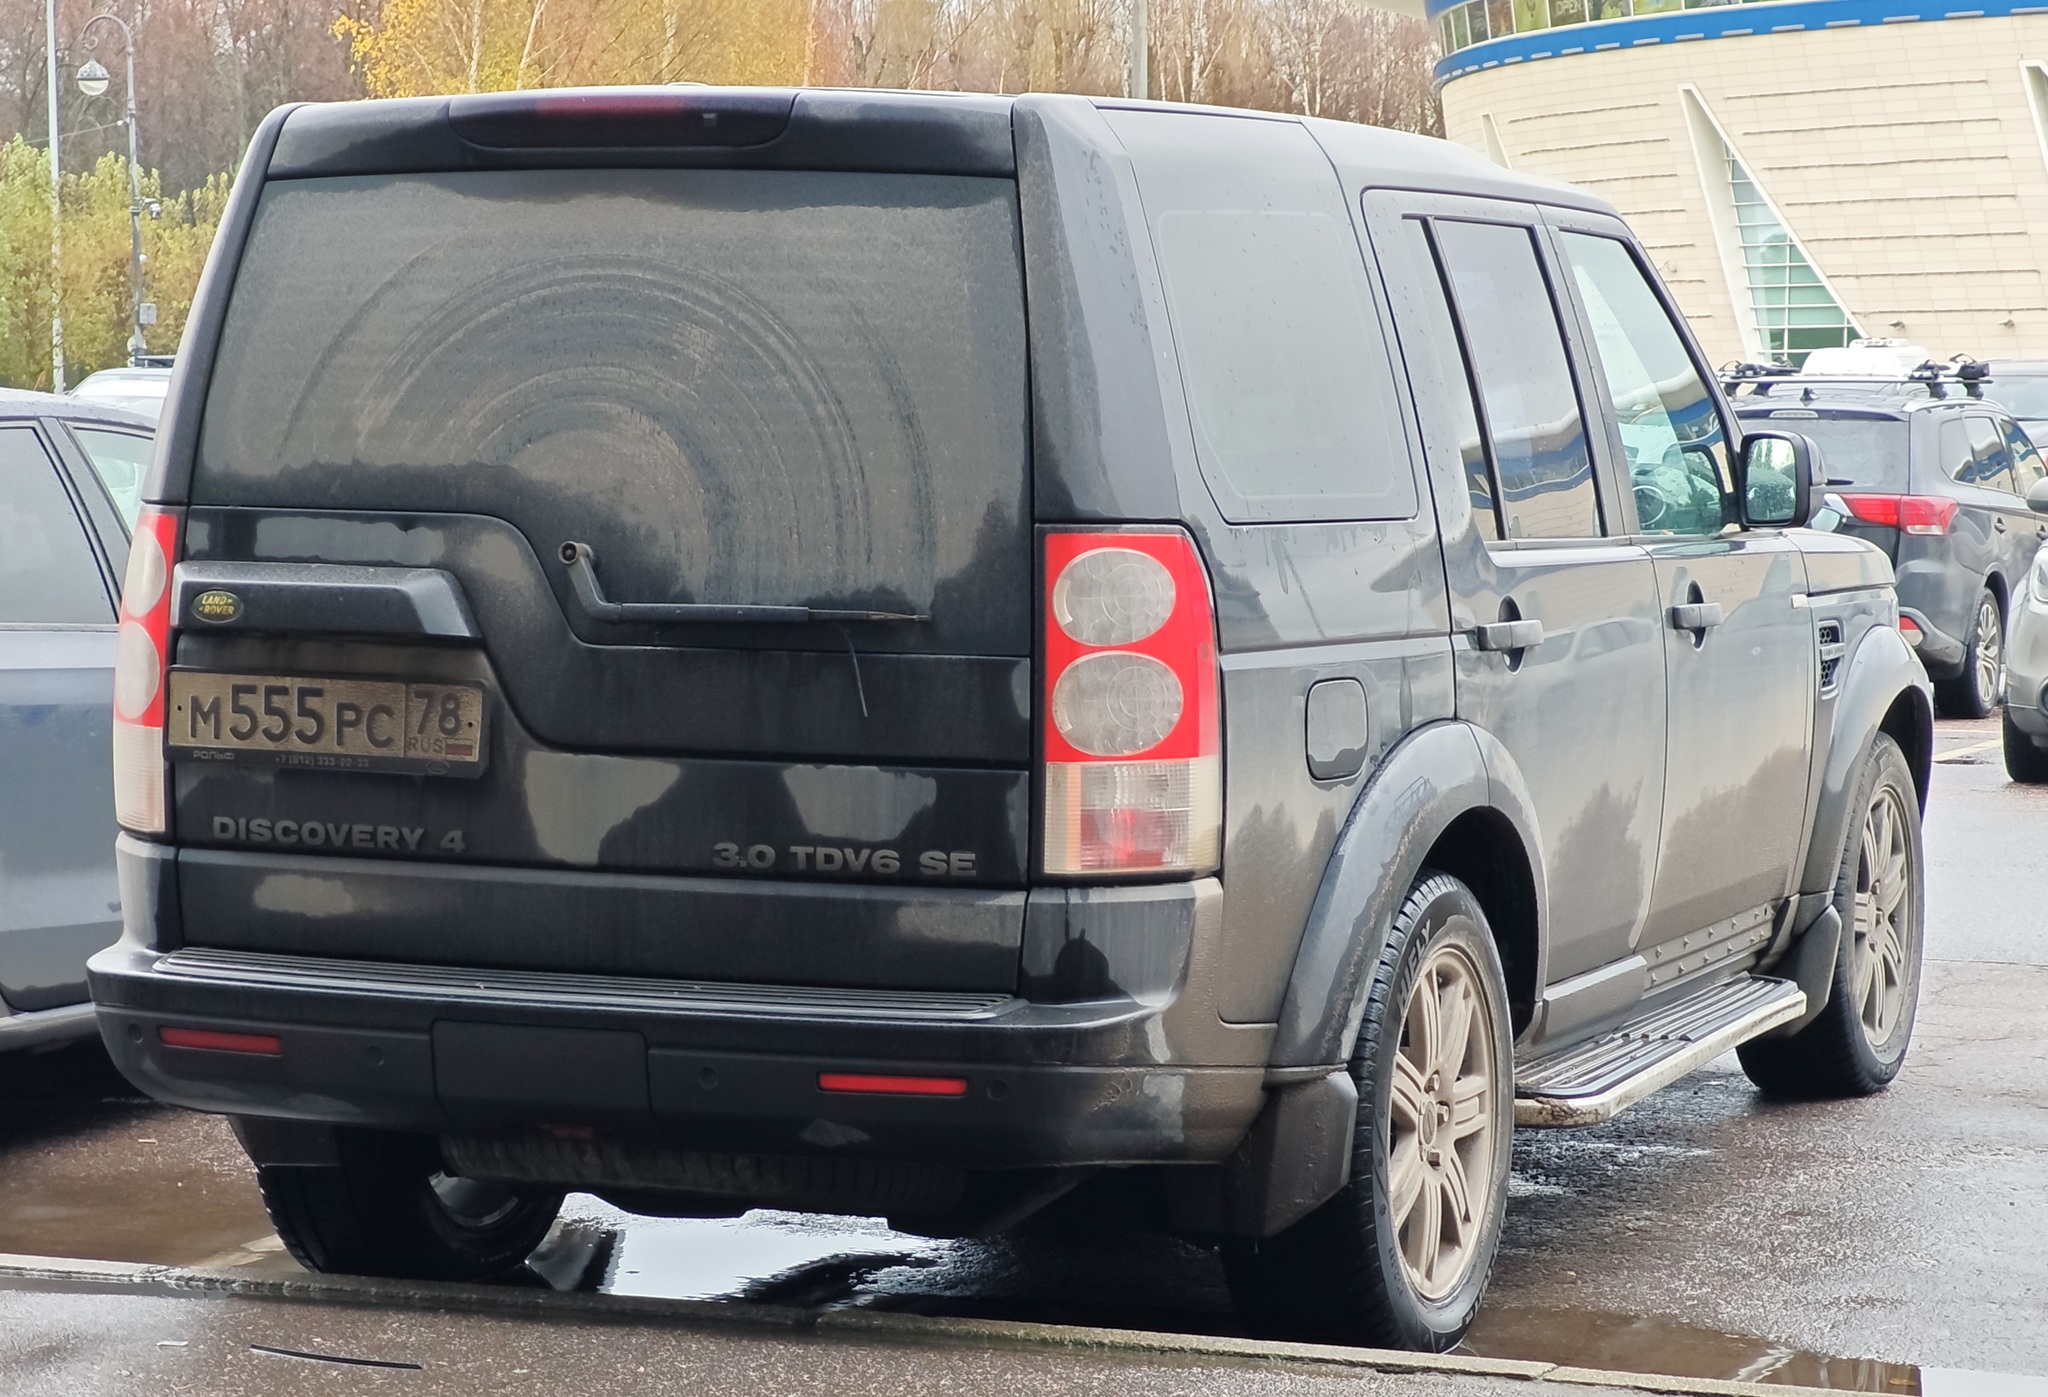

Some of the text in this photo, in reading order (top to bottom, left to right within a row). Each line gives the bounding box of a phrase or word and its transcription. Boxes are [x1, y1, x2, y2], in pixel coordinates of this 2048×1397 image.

[201, 595, 228, 605] LAND
[203, 604, 235, 615] ROVER
[413, 689, 461, 736] 78
[407, 737, 445, 753] RUS
[212, 816, 467, 853] DISCOVERY 4
[712, 842, 977, 877] 3.0 TDV6 SE
